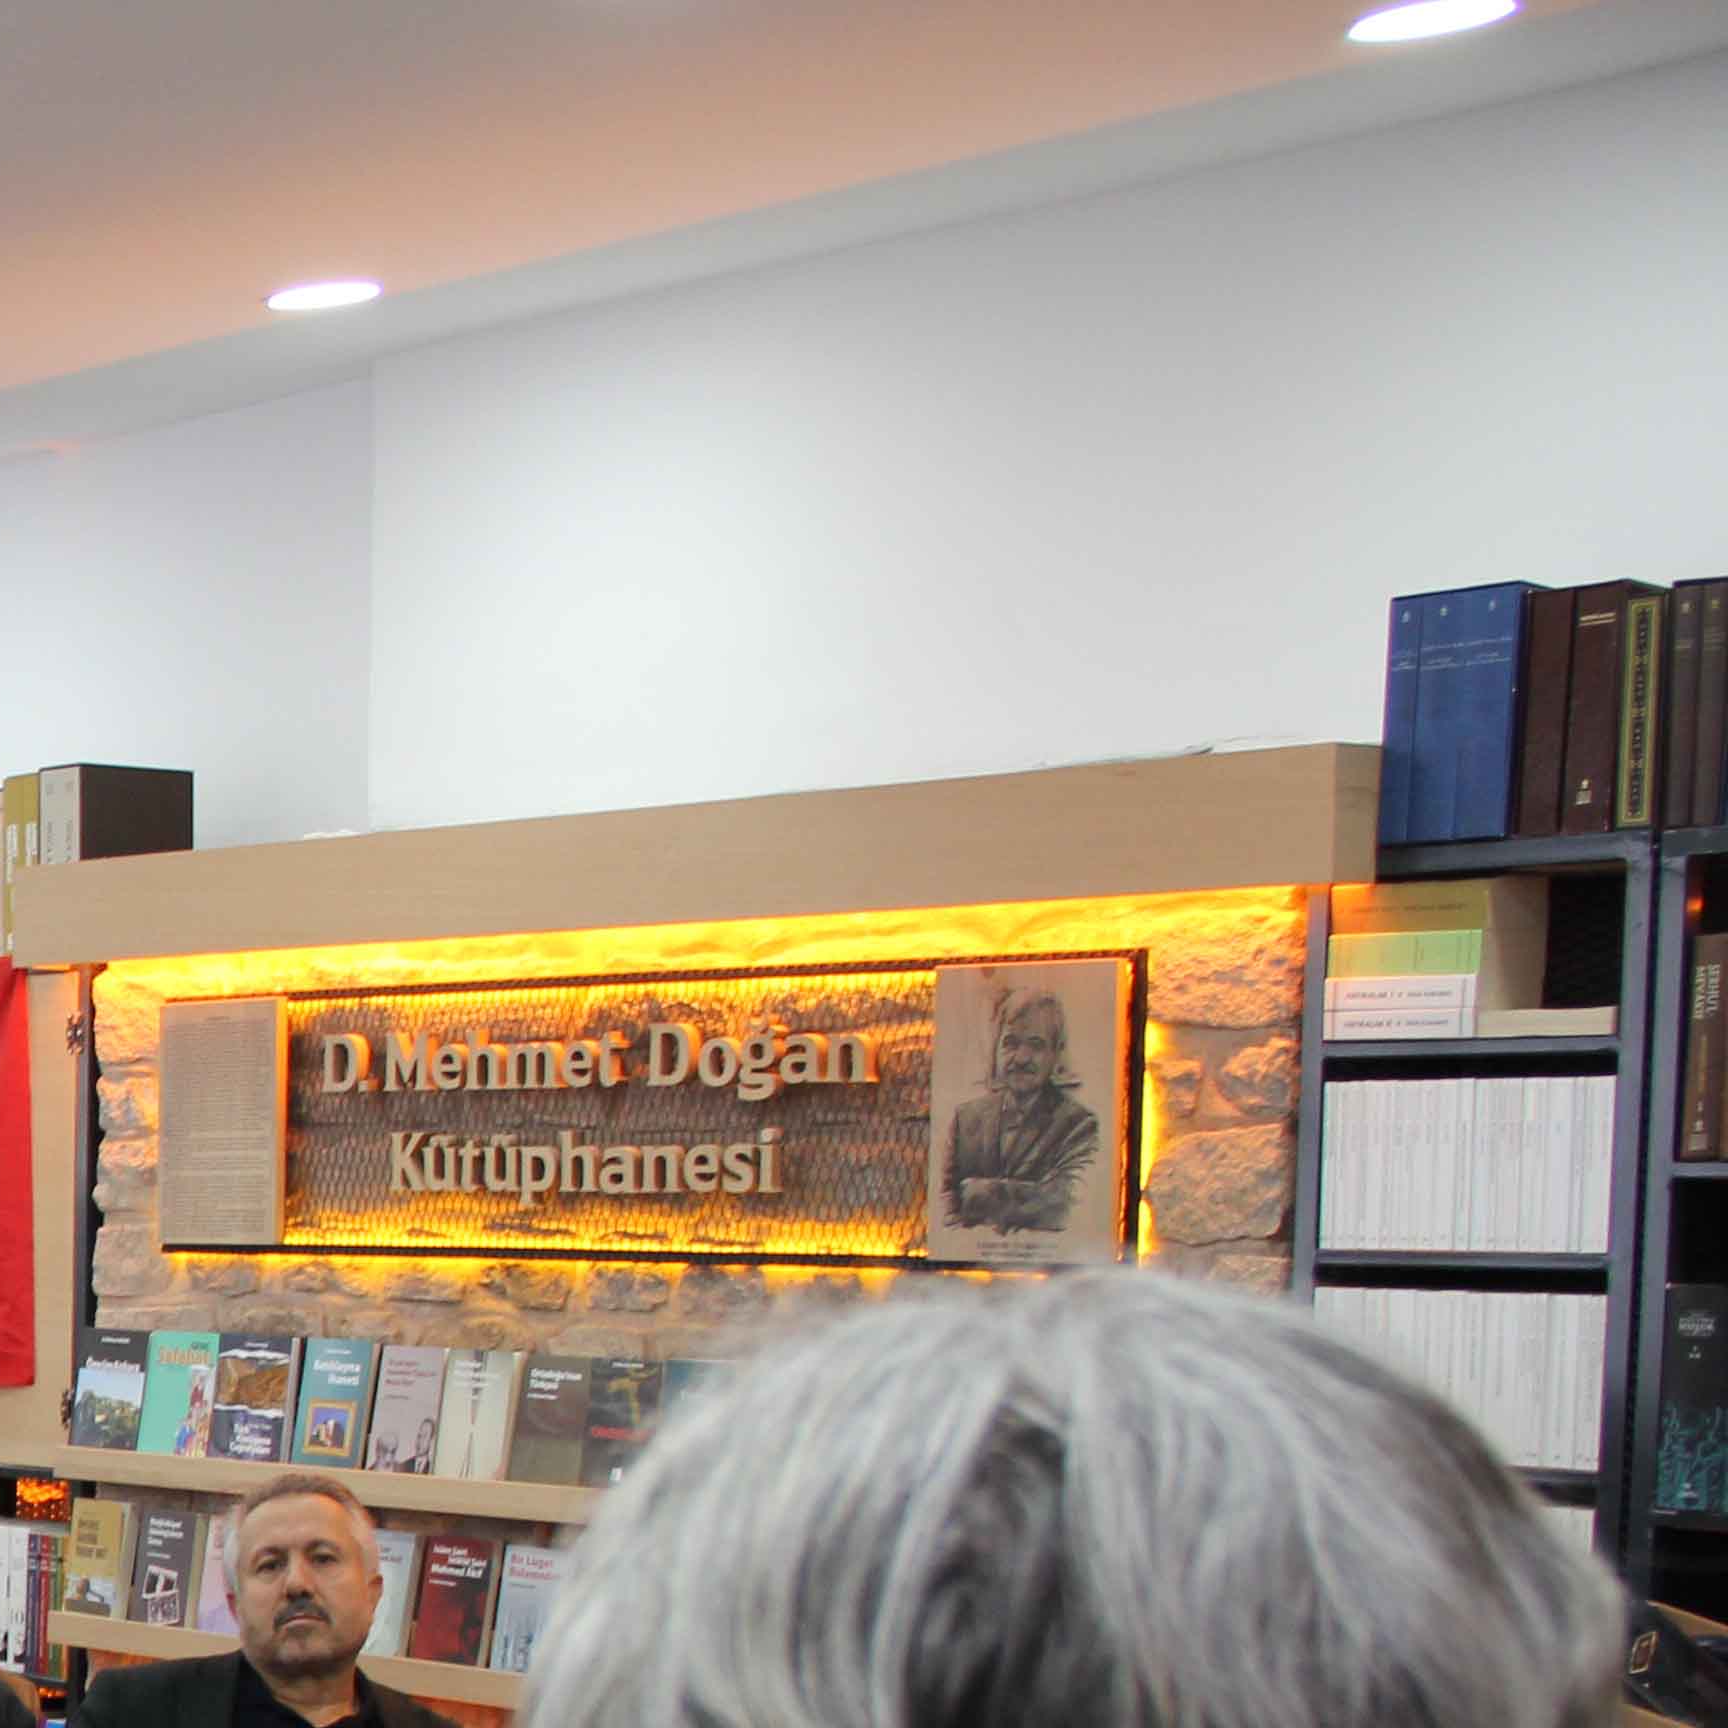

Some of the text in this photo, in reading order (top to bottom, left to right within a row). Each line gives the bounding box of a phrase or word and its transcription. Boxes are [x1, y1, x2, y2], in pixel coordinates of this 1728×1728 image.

[321, 1013, 880, 1100] D. Mehmet Doğan
[389, 1127, 783, 1207] Kütüphanesi
